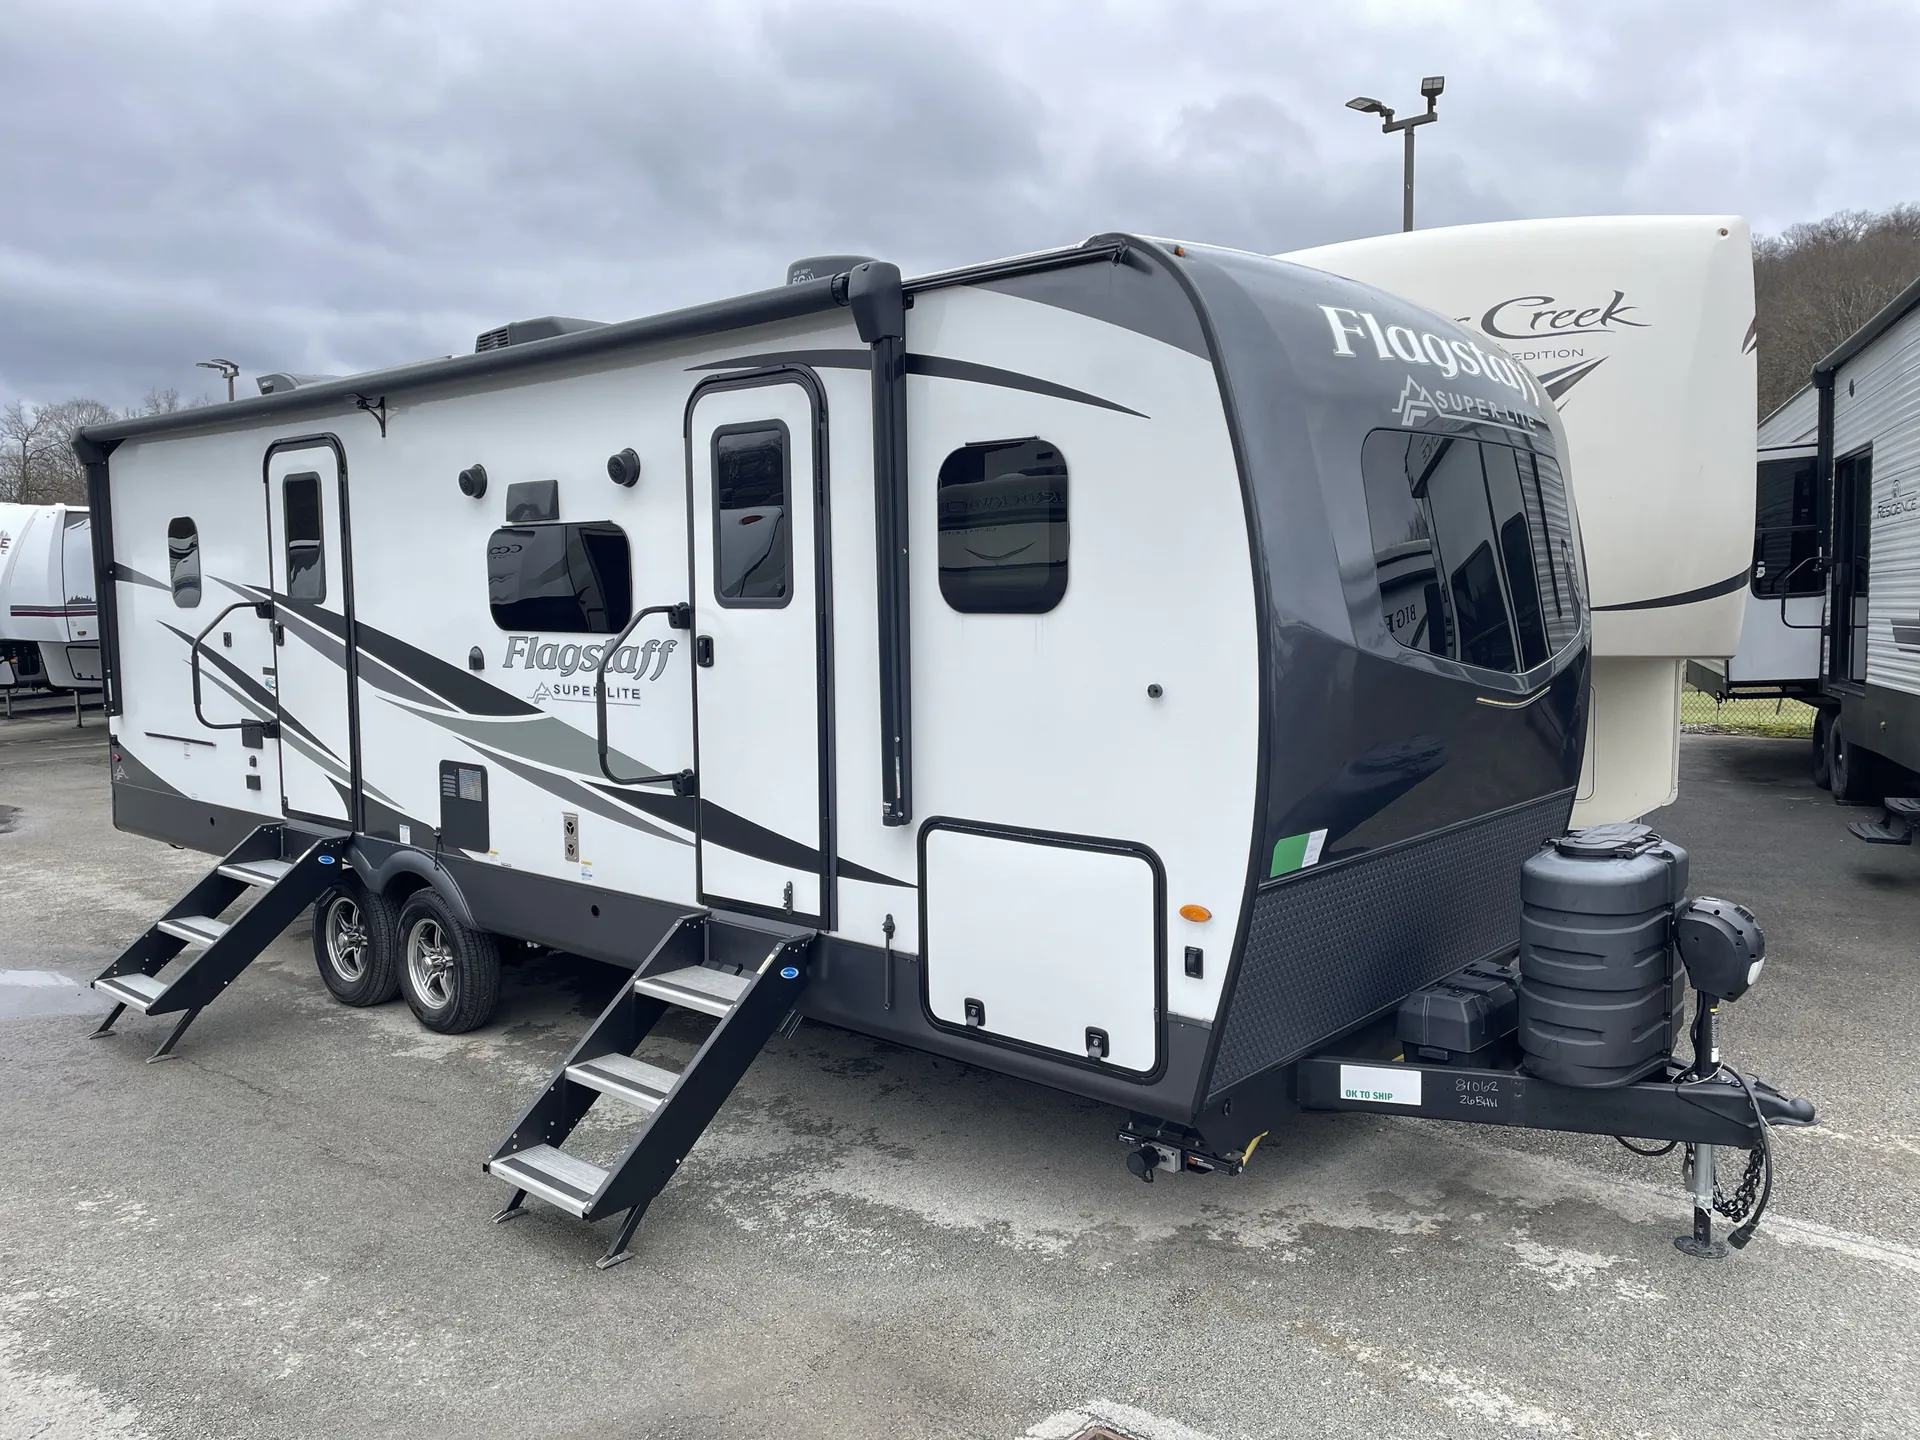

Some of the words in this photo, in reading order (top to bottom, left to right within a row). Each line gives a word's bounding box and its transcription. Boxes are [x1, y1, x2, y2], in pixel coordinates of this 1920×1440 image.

[1481, 289, 1652, 339] Creek
[1316, 303, 1540, 409] Flagstaff
[1512, 348, 1584, 361] EDITION
[1436, 391, 1501, 420] SUPER
[1504, 407, 1537, 430] LITE
[503, 636, 678, 681] Flagstaff
[607, 687, 641, 700] LITE
[1345, 1089, 1358, 1098] OK
[1360, 1091, 1371, 1099] TO
[1373, 1091, 1394, 1101] SHIP
